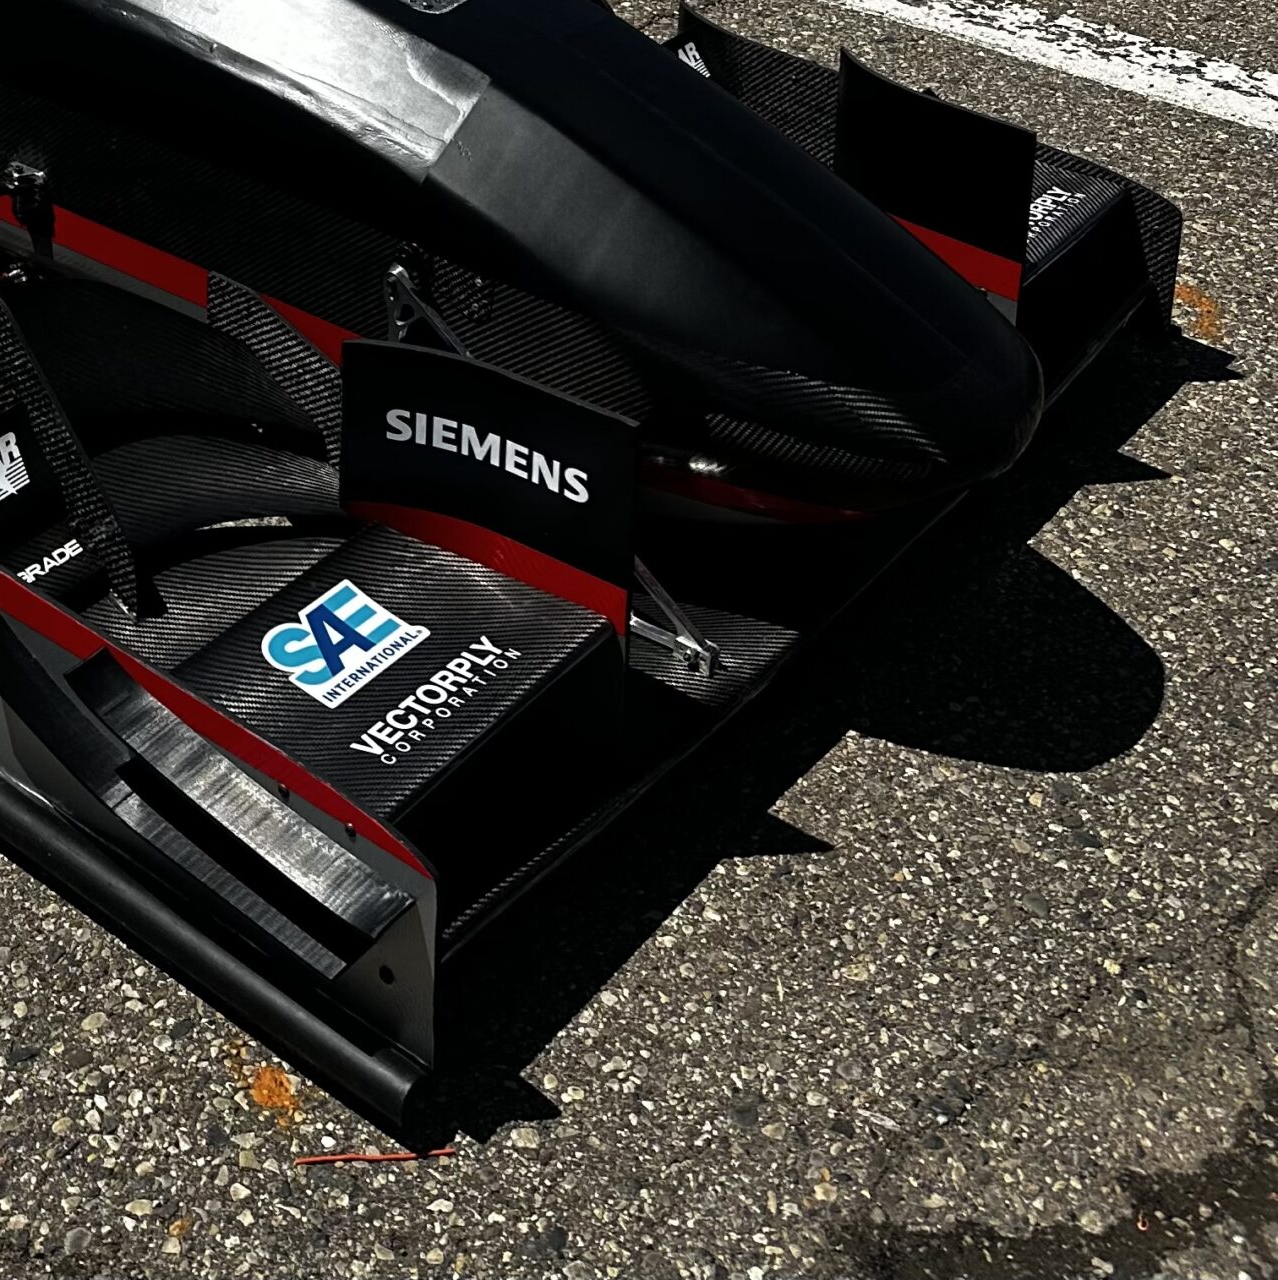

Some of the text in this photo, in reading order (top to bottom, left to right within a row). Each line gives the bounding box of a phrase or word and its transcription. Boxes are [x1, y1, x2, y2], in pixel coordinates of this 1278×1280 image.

[386, 408, 589, 503] SIEMENS
[267, 585, 403, 686] SAE
[350, 635, 504, 759] VECTORPLY
[380, 646, 522, 766] CORPORATION
